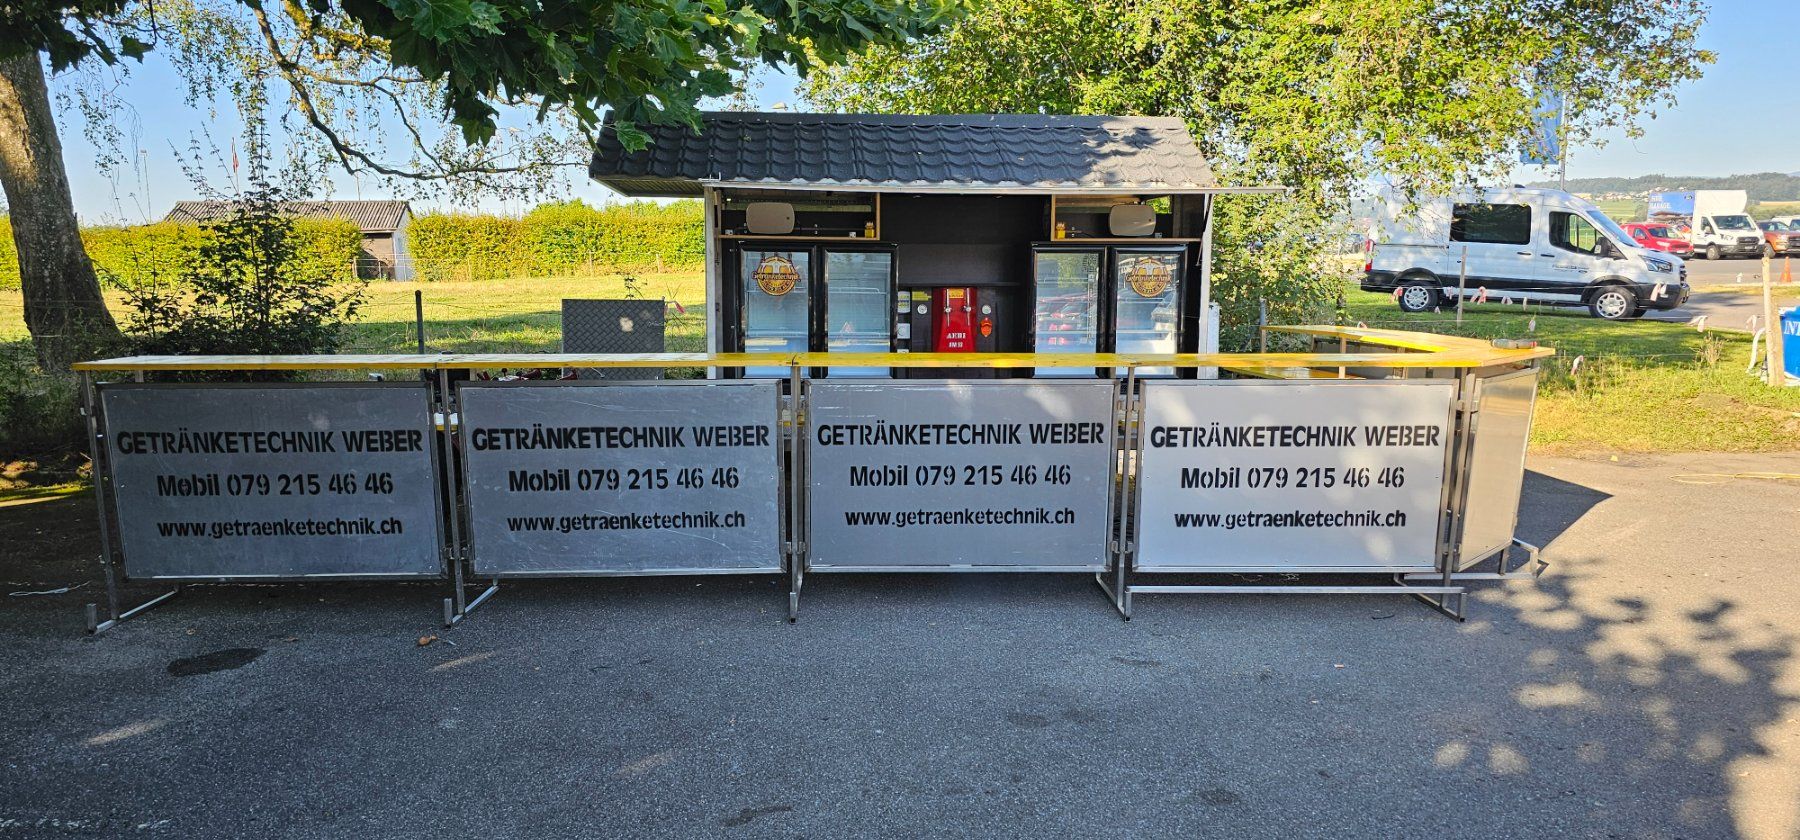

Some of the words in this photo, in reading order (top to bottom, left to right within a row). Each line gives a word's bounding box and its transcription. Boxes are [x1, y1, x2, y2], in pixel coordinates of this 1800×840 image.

[116, 428, 336, 454] GETRÄNKETECHNIK
[342, 430, 423, 453] WEBER
[472, 424, 686, 451] GETRÄNKETECHNIK
[693, 425, 770, 447] WEBER
[817, 420, 1022, 446] GETRÄNKETECHNIK
[1029, 423, 1105, 445] WEBER
[1150, 423, 1357, 449] GETRÄNKETECHNIK
[1364, 425, 1441, 448] WEBER
[157, 474, 220, 497] Mobil
[228, 475, 270, 496] 079
[279, 474, 321, 496] 215
[329, 473, 357, 495] 46
[365, 473, 394, 495] 46
[509, 469, 571, 492] Mobil
[578, 469, 620, 491] 079
[628, 469, 669, 490] 215
[677, 468, 704, 489] 46
[712, 467, 740, 489] 46
[850, 465, 908, 487] Mobil
[916, 466, 956, 486] 079
[964, 465, 1003, 486] 215
[1011, 465, 1038, 486] 46
[1045, 465, 1072, 486] 46
[1181, 467, 1241, 489] Mobil
[1248, 468, 1289, 489] 079
[1296, 467, 1336, 489] 215
[1343, 467, 1371, 489] 46
[1378, 467, 1406, 489] 46
[157, 517, 403, 540] www.getraenketechnik.ch
[507, 510, 746, 534] www.getraenketechnik.ch
[845, 507, 1076, 528] www.getraenketechnik.ch
[1174, 510, 1407, 531] www.getraenketechnik.ch
